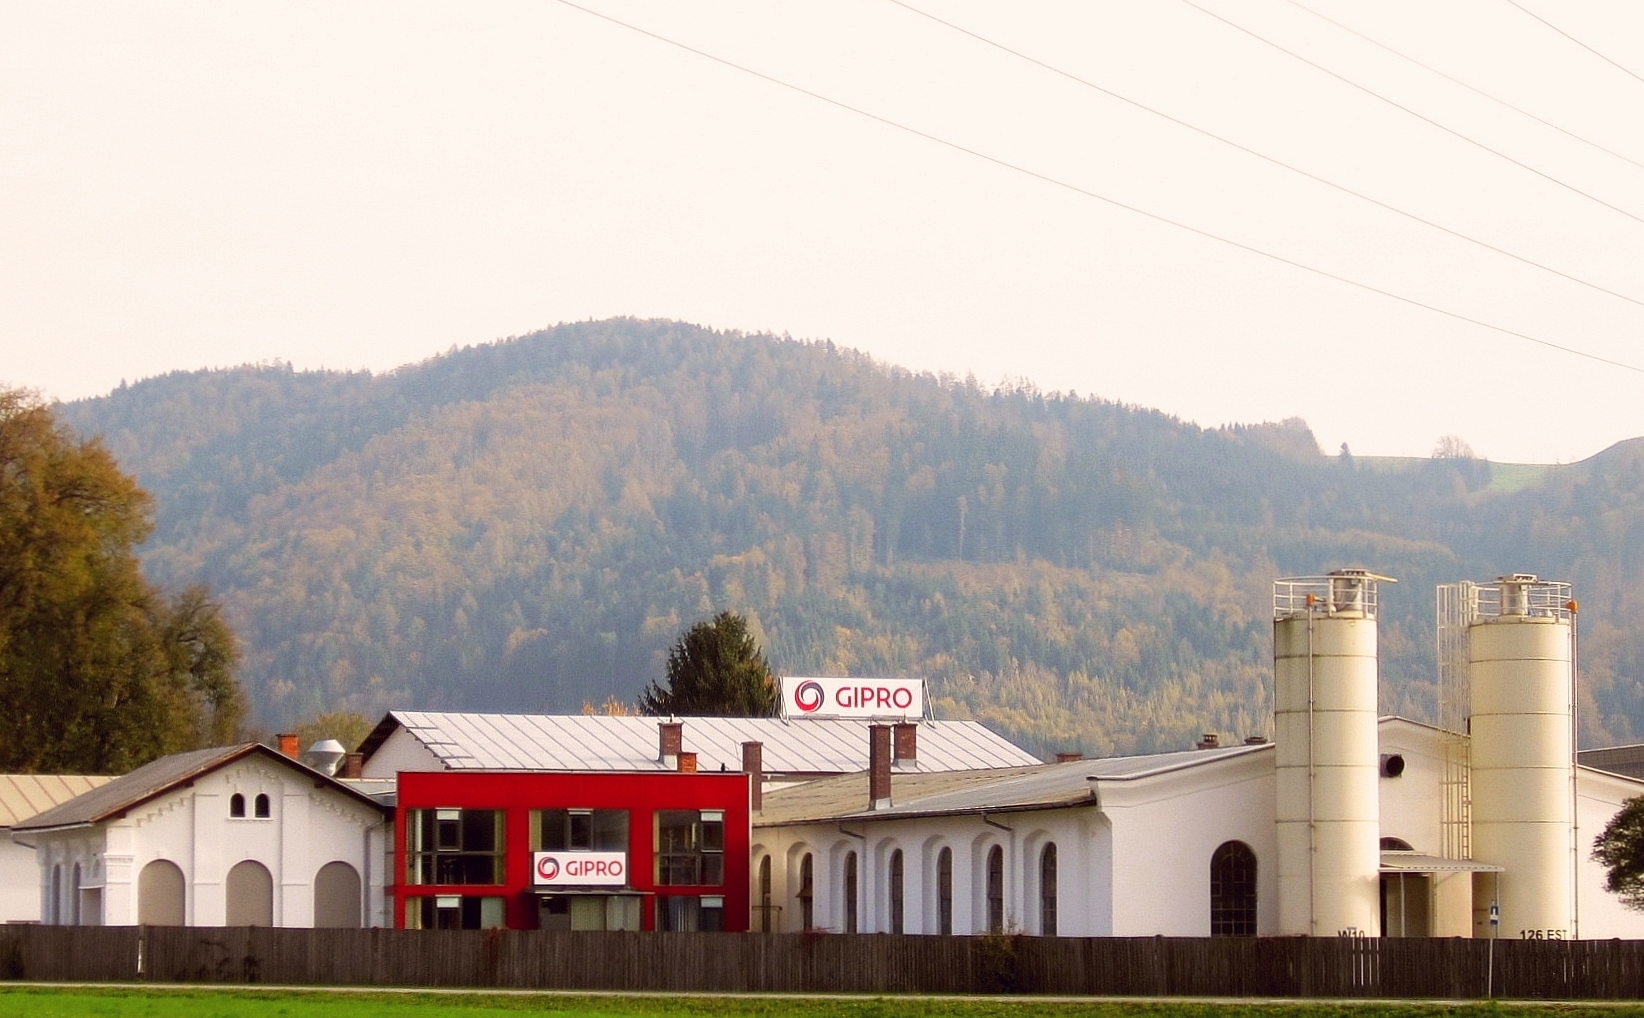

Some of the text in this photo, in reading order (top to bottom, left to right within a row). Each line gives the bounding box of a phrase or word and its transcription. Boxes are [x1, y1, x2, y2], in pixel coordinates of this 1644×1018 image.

[836, 687, 912, 708] GIPRO
[565, 860, 623, 877] GIPRO
[1520, 929, 1543, 940] 126
